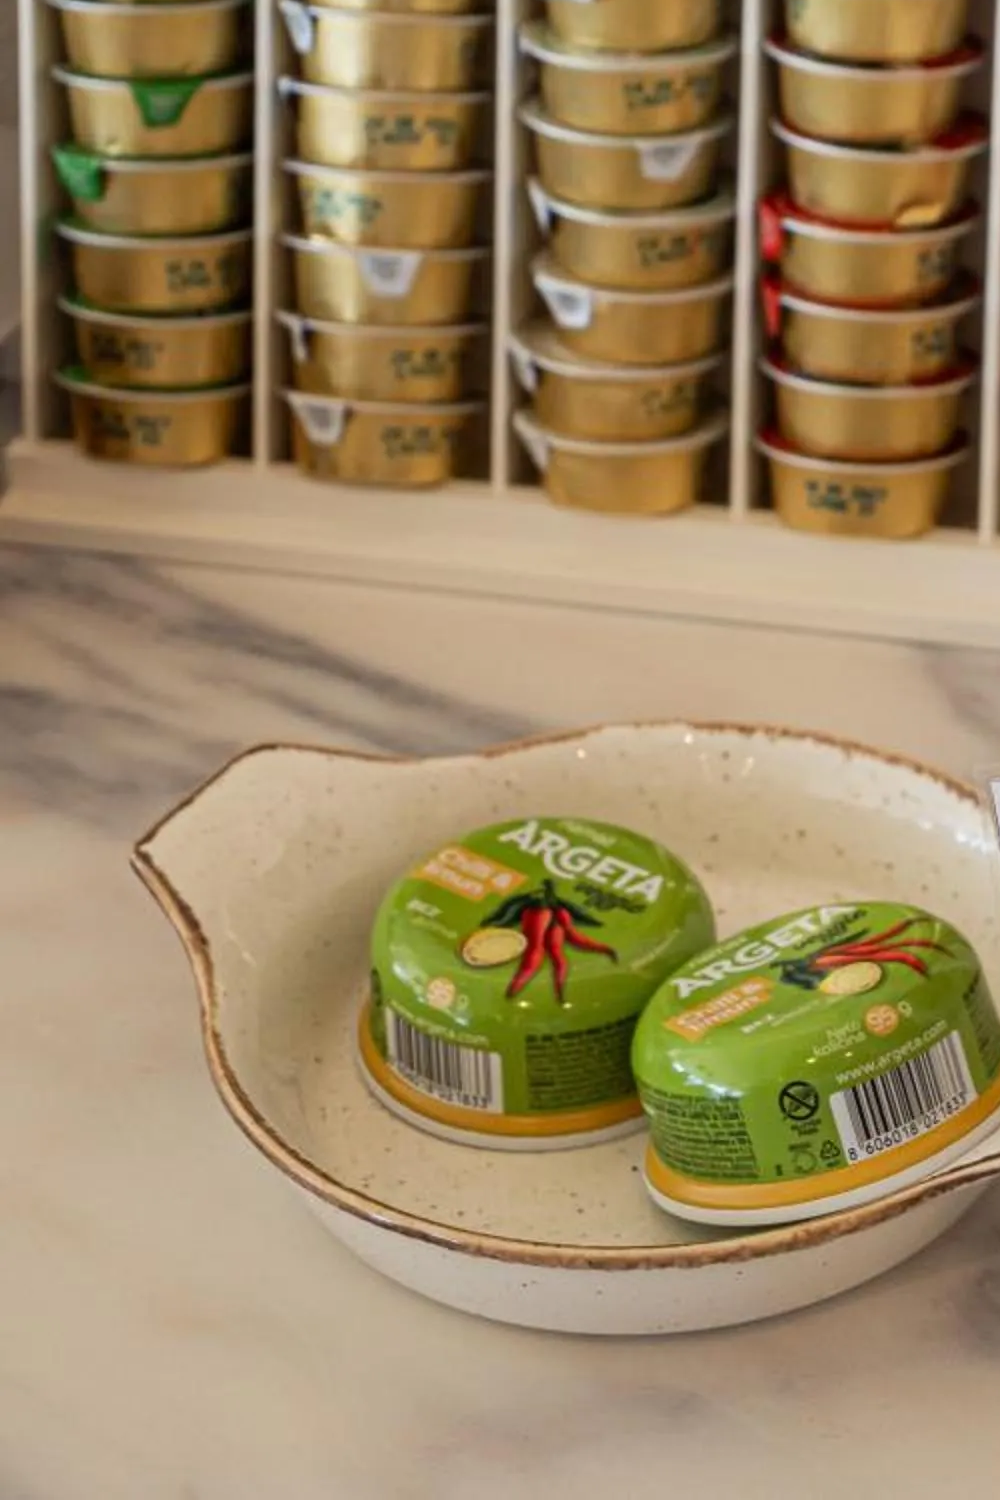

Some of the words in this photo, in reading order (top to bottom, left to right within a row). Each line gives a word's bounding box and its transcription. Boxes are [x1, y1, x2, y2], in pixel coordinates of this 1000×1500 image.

[498, 820, 665, 903] ARGETA
[670, 906, 858, 999] ARGETA
[849, 1147, 860, 1161] 8
